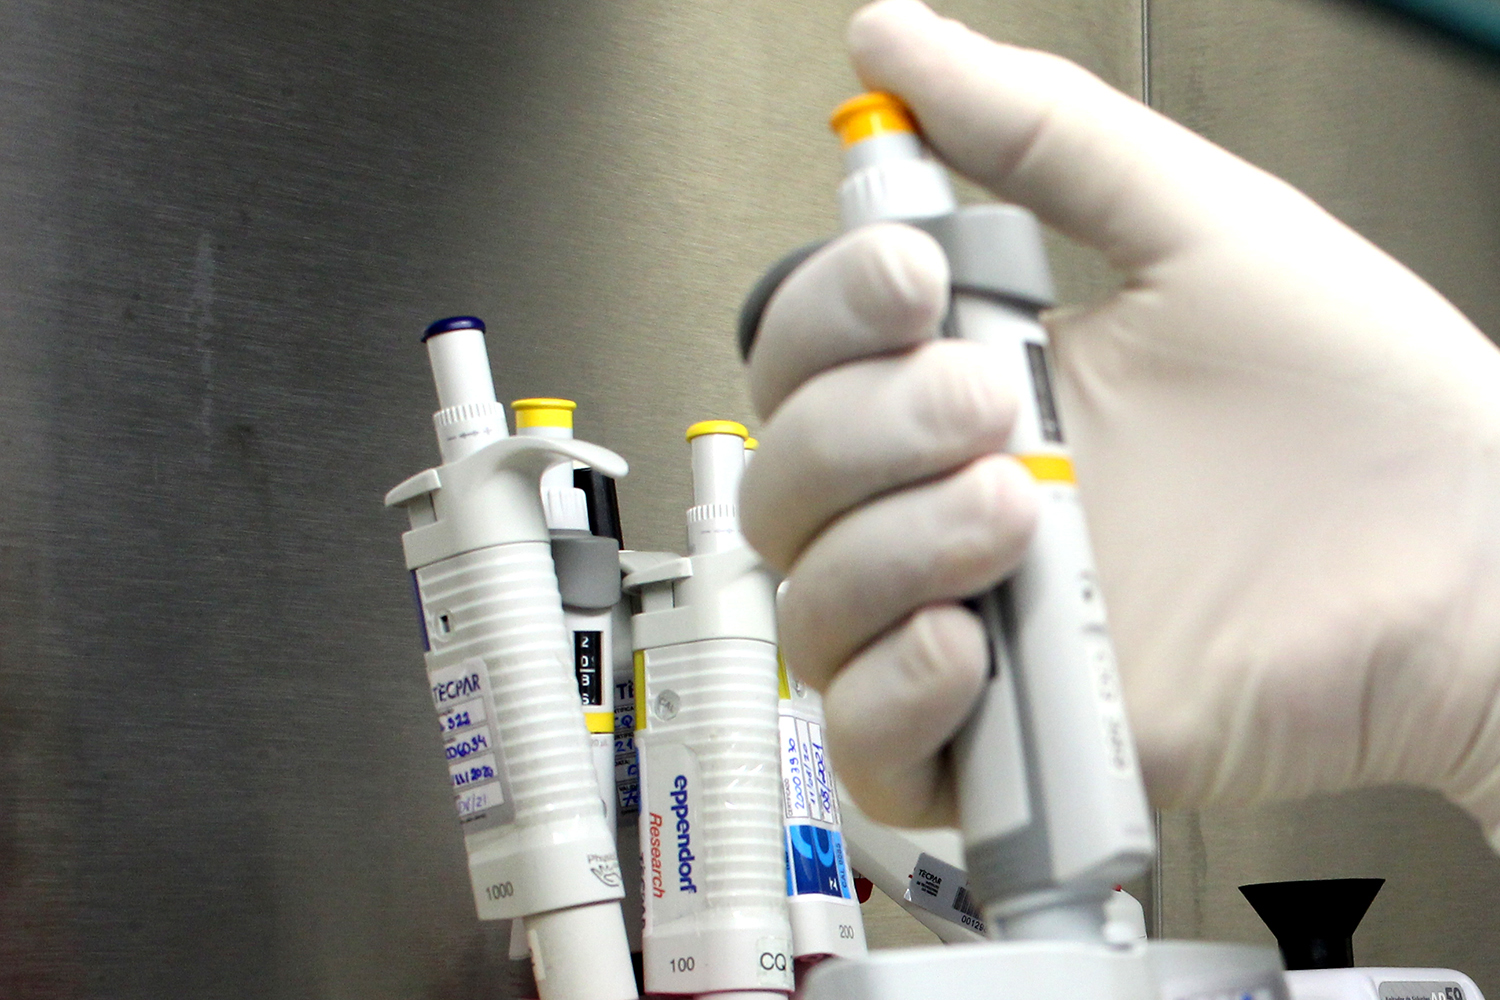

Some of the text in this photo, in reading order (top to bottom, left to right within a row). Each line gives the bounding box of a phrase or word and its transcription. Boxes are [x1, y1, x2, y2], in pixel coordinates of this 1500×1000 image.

[670, 774, 698, 894] eppendorf
[649, 811, 666, 899] Research
[486, 881, 515, 901] 1000
[838, 924, 855, 940] 200
[670, 956, 696, 973] 100
[759, 951, 787, 972] CQ
